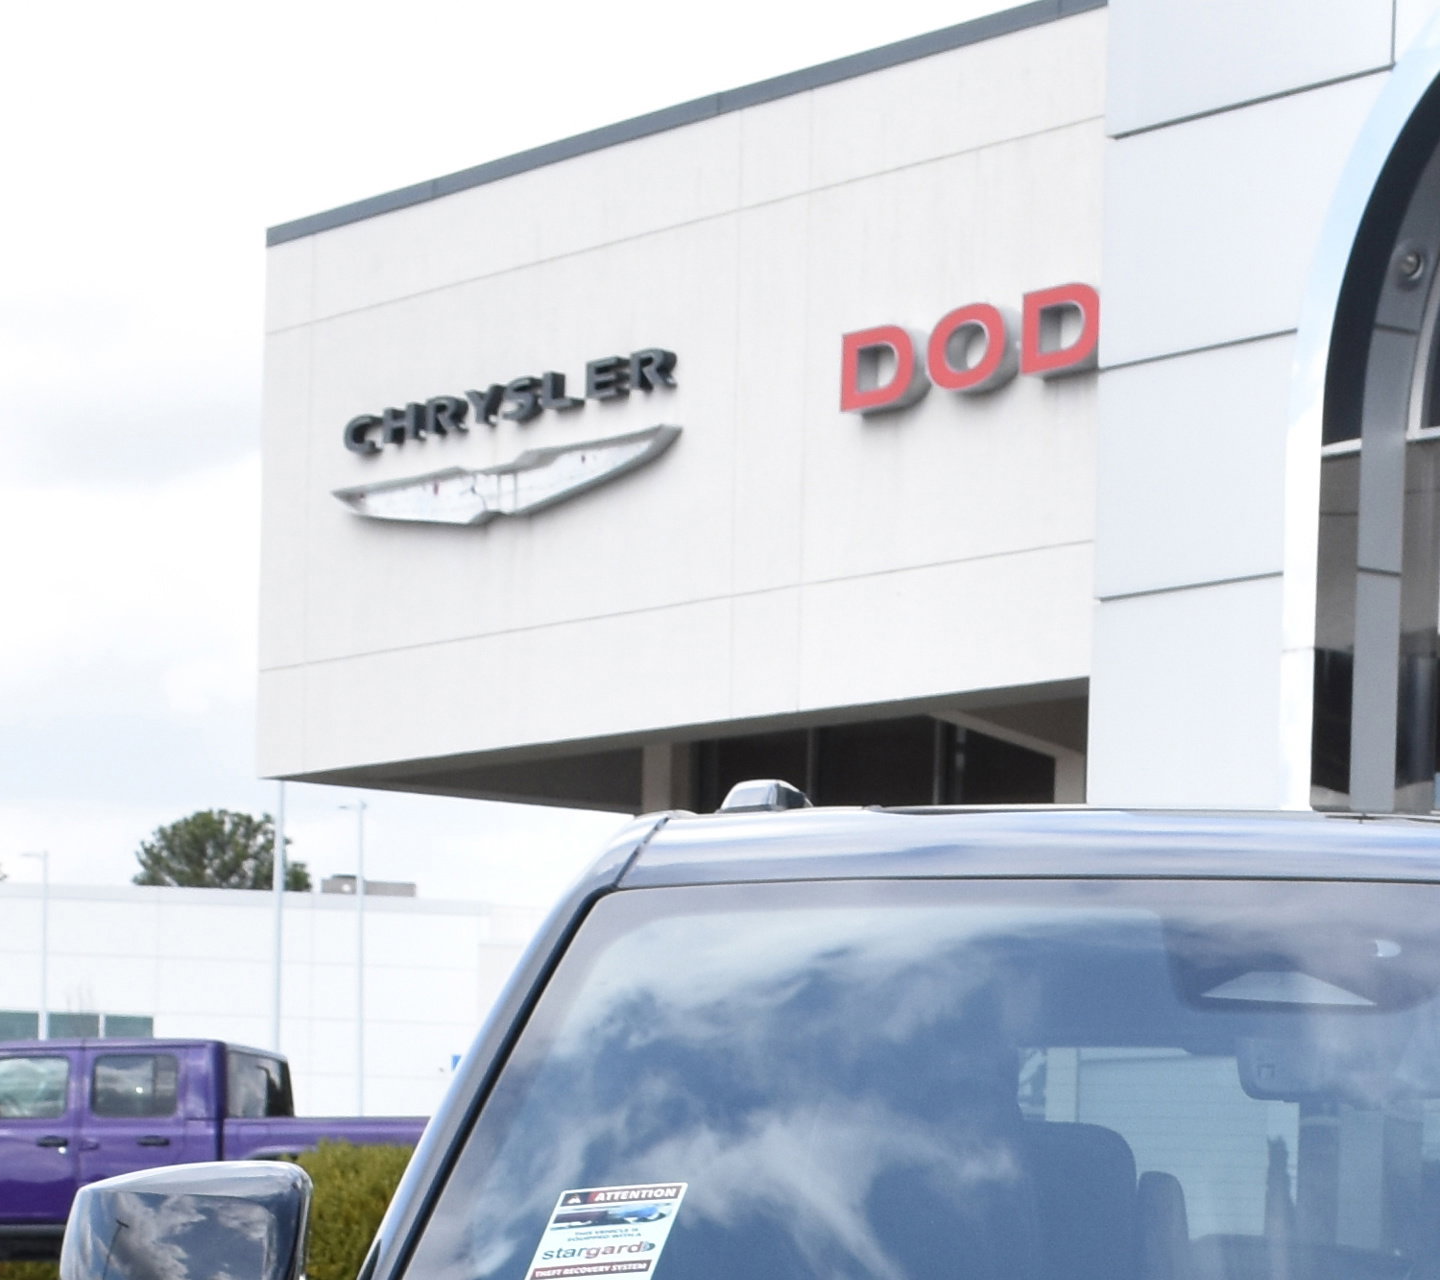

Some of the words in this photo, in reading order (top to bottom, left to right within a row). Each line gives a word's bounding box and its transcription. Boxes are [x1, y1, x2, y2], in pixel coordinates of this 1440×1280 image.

[343, 348, 677, 455] CHRYSLER
[593, 1187, 678, 1202] ATTENTION
[534, 1268, 562, 1278] THEFT
[563, 1264, 611, 1276] RECOVERY
[611, 1261, 647, 1273] SYSTEM
